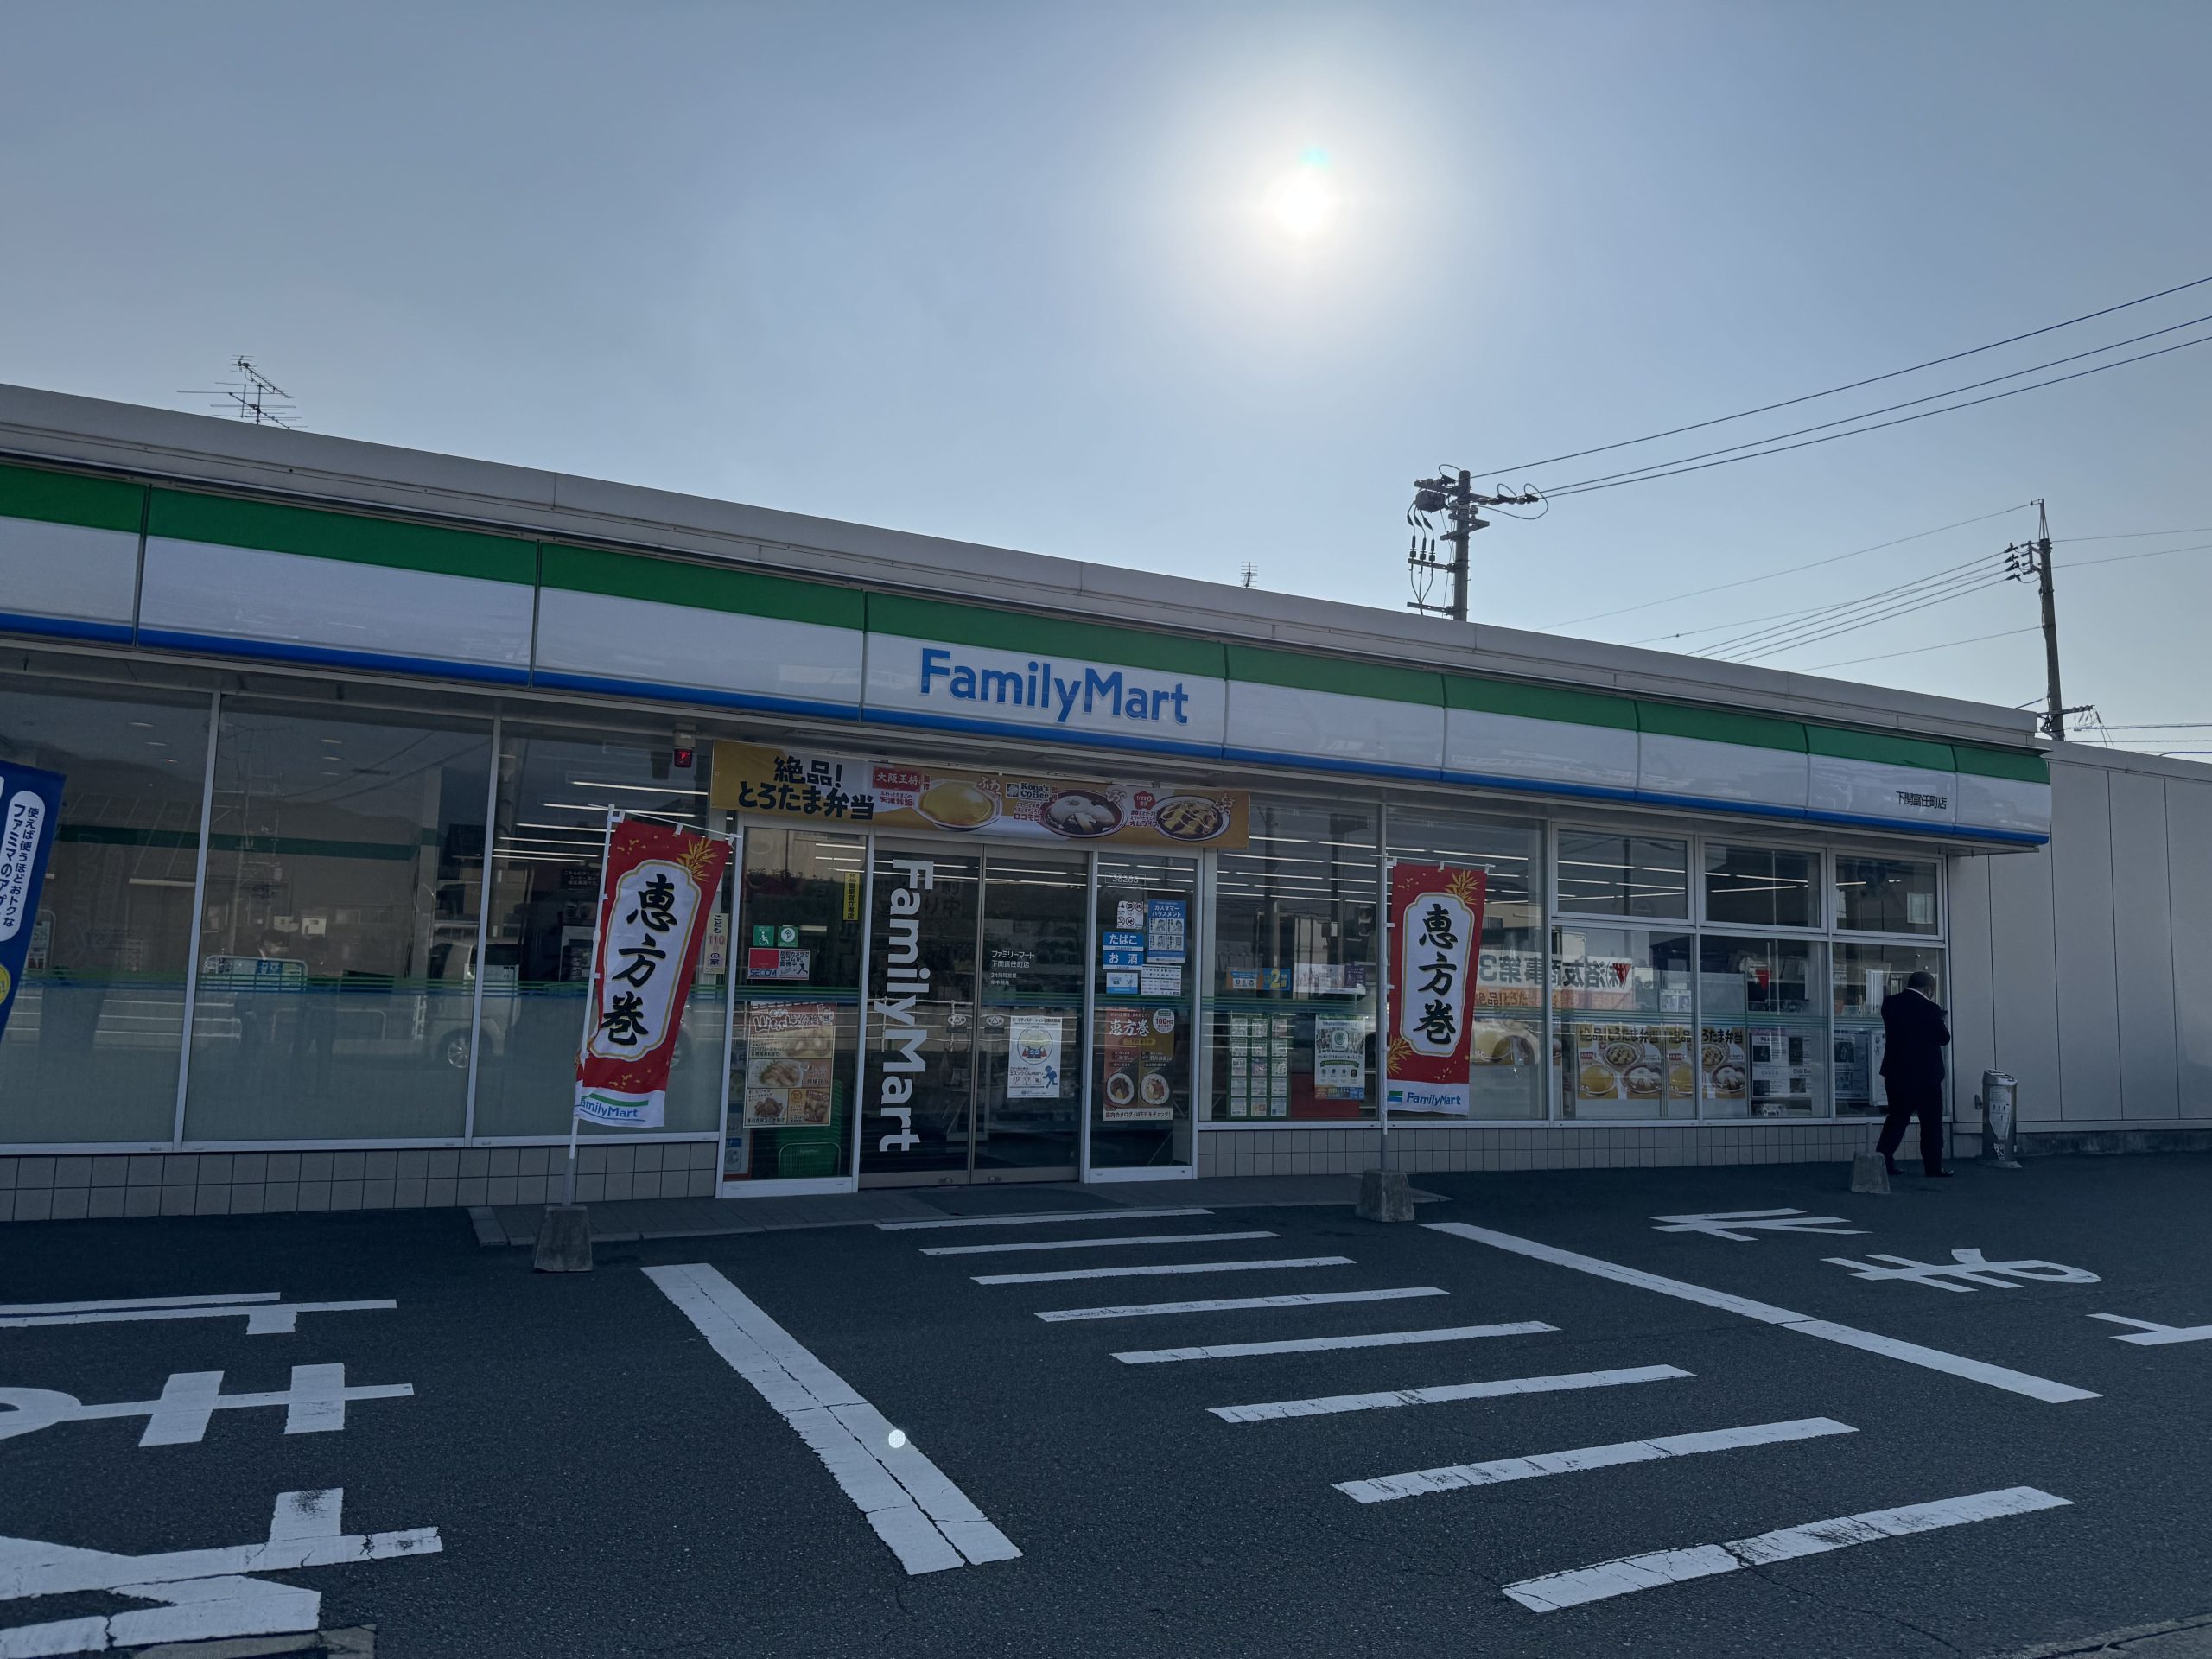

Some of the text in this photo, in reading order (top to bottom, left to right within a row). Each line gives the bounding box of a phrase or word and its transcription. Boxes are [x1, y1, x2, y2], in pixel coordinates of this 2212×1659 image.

[920, 647, 1190, 724] FamilyMart
[773, 755, 843, 788] 絶品!
[876, 772, 919, 785] 大阪王将
[1020, 782, 1050, 791] Kona's
[1020, 790, 1050, 799] Coffee
[738, 780, 874, 820] とろたま弁当
[1896, 791, 1948, 810] 下関富任町店
[0, 804, 26, 916] ファミマのアプ
[3, 806, 41, 927] 使えば使うほどおトクな
[1109, 933, 1138, 945] たばこ
[601, 873, 677, 1046] 恵方巻
[991, 950, 1035, 960] ファミリーマート
[991, 959, 1030, 969] 下関富任町店
[749, 969, 778, 977] SECOM
[1414, 903, 1458, 1045] 恵方巻
[873, 858, 934, 1153] FamilyMart
[1109, 1018, 1150, 1037] 恵方巻
[581, 1096, 639, 1117] amilyMart
[1406, 1091, 1462, 1107] FamilyMart
